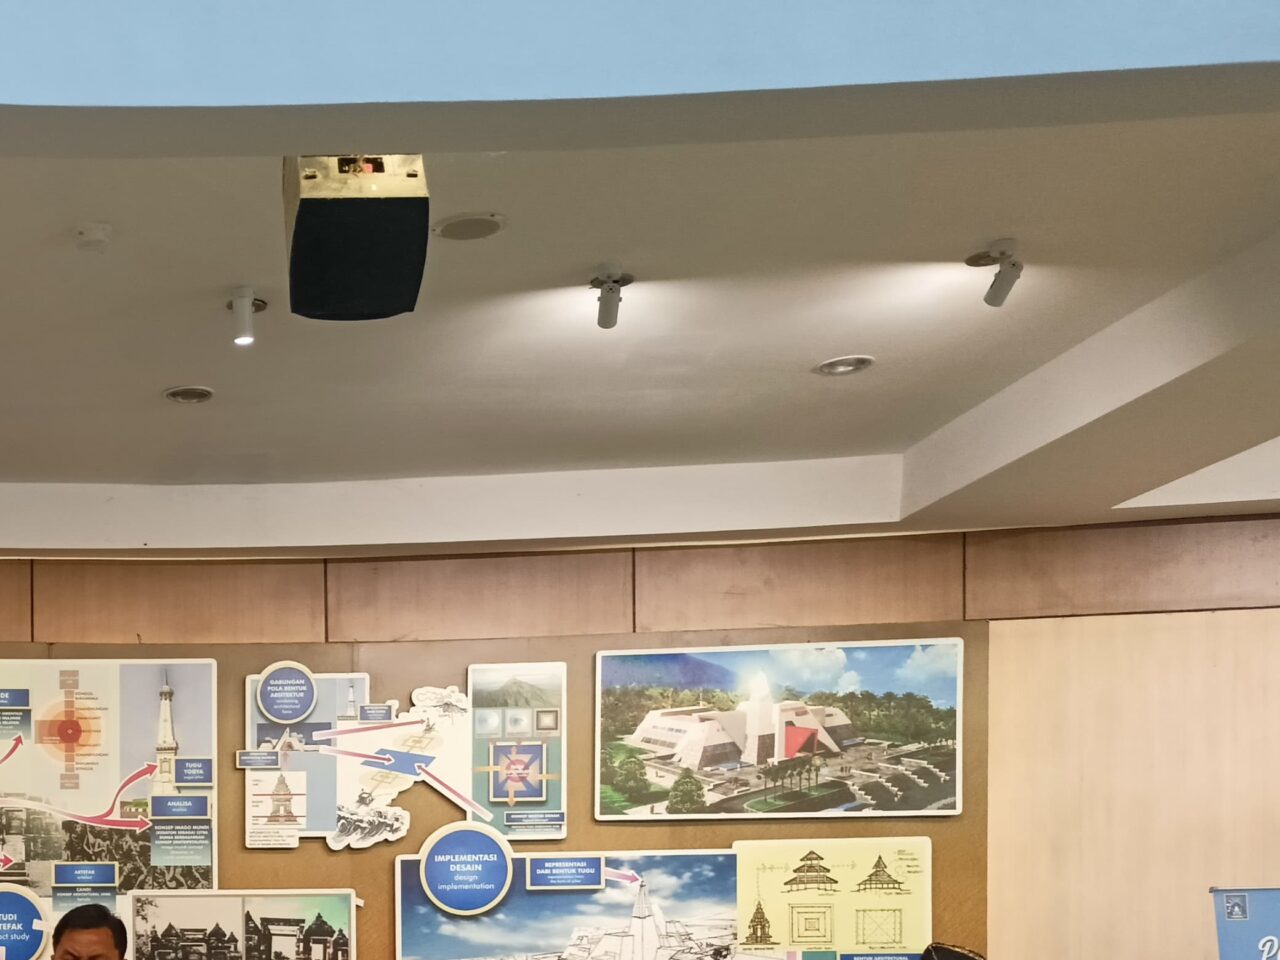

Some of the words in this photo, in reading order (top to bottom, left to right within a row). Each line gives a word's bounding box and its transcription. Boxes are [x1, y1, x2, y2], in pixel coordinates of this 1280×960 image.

[434, 854, 497, 862] IMPLEMENTASI
[449, 864, 482, 872] DESAIN
[453, 874, 478, 882] design
[437, 882, 495, 891] implementation
[10, 932, 30, 942] study
